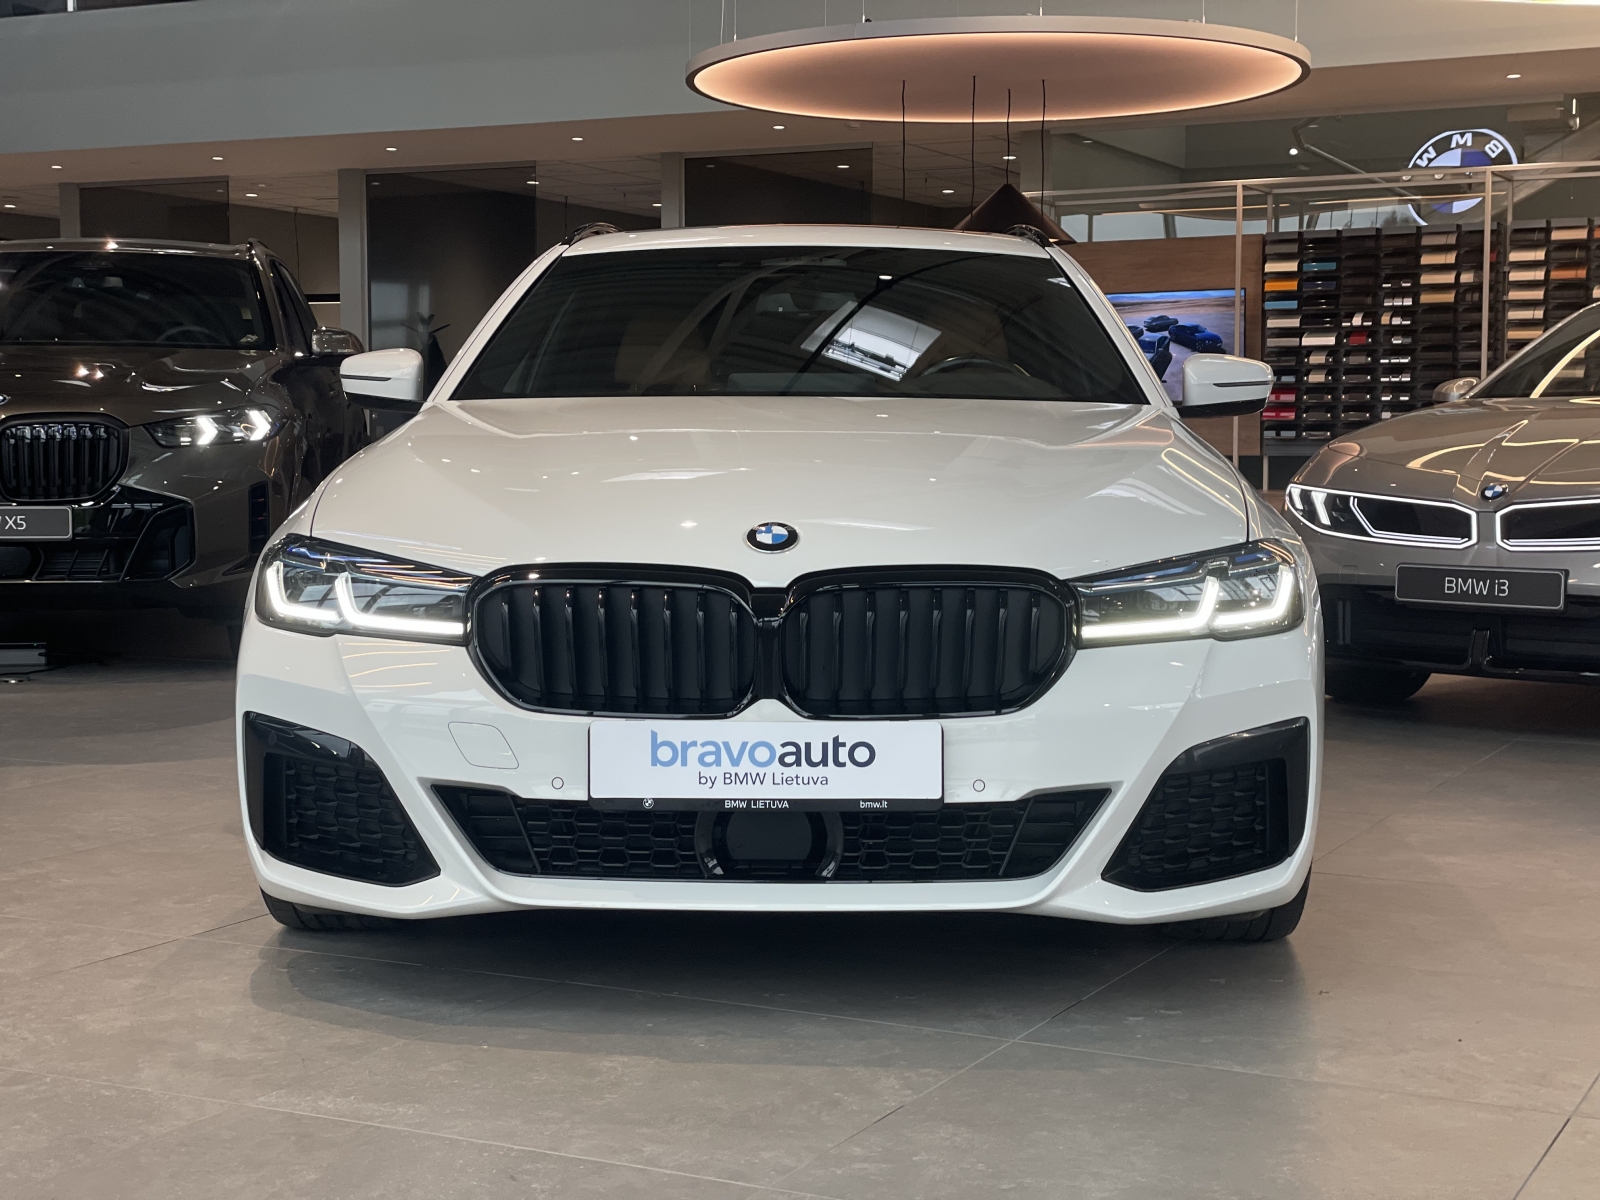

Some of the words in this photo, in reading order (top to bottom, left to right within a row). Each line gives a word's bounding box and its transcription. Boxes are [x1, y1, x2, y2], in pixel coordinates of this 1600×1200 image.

[5, 515, 27, 530] X5
[1444, 576, 1490, 595] BMW
[1495, 579, 1509, 597] i3
[650, 730, 876, 768] bravoauto
[698, 771, 716, 789] by
[723, 772, 766, 786] BMW
[772, 772, 829, 786] Lietuva
[724, 800, 747, 809] BMW
[751, 800, 789, 809] LIETUVA
[859, 800, 888, 809] bmw.lt
